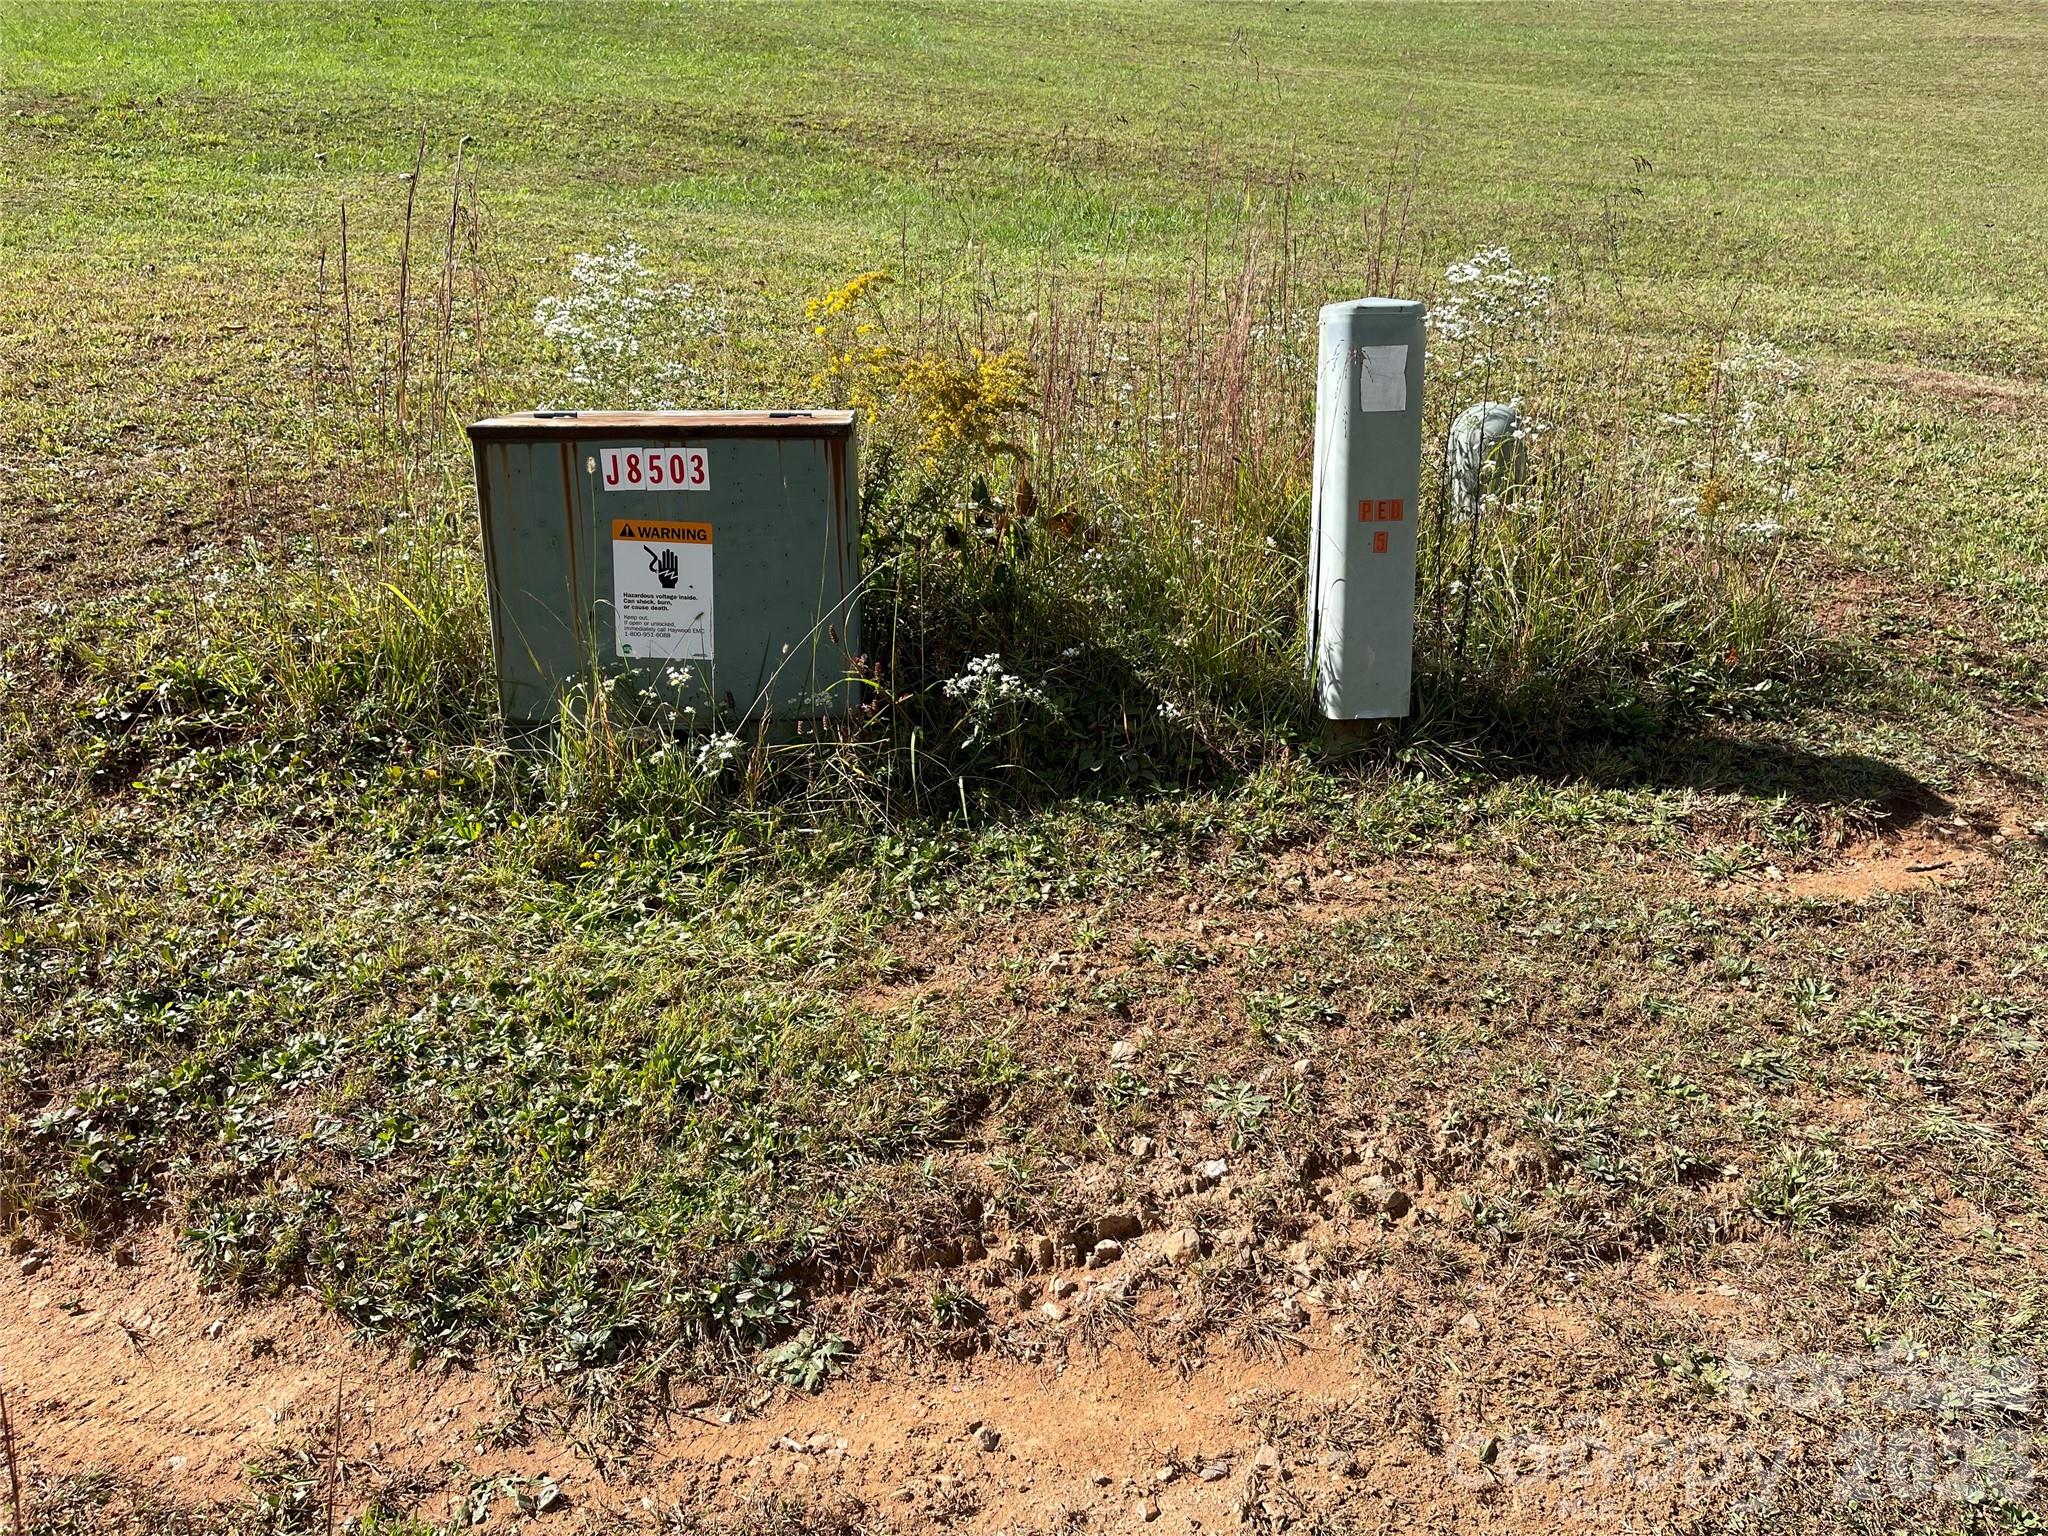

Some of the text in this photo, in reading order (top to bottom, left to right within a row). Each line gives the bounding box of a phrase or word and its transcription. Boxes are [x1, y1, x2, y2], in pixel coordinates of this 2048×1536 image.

[606, 453, 705, 486] J8503
[637, 526, 708, 541] WARNING
[655, 593, 677, 601] voltage
